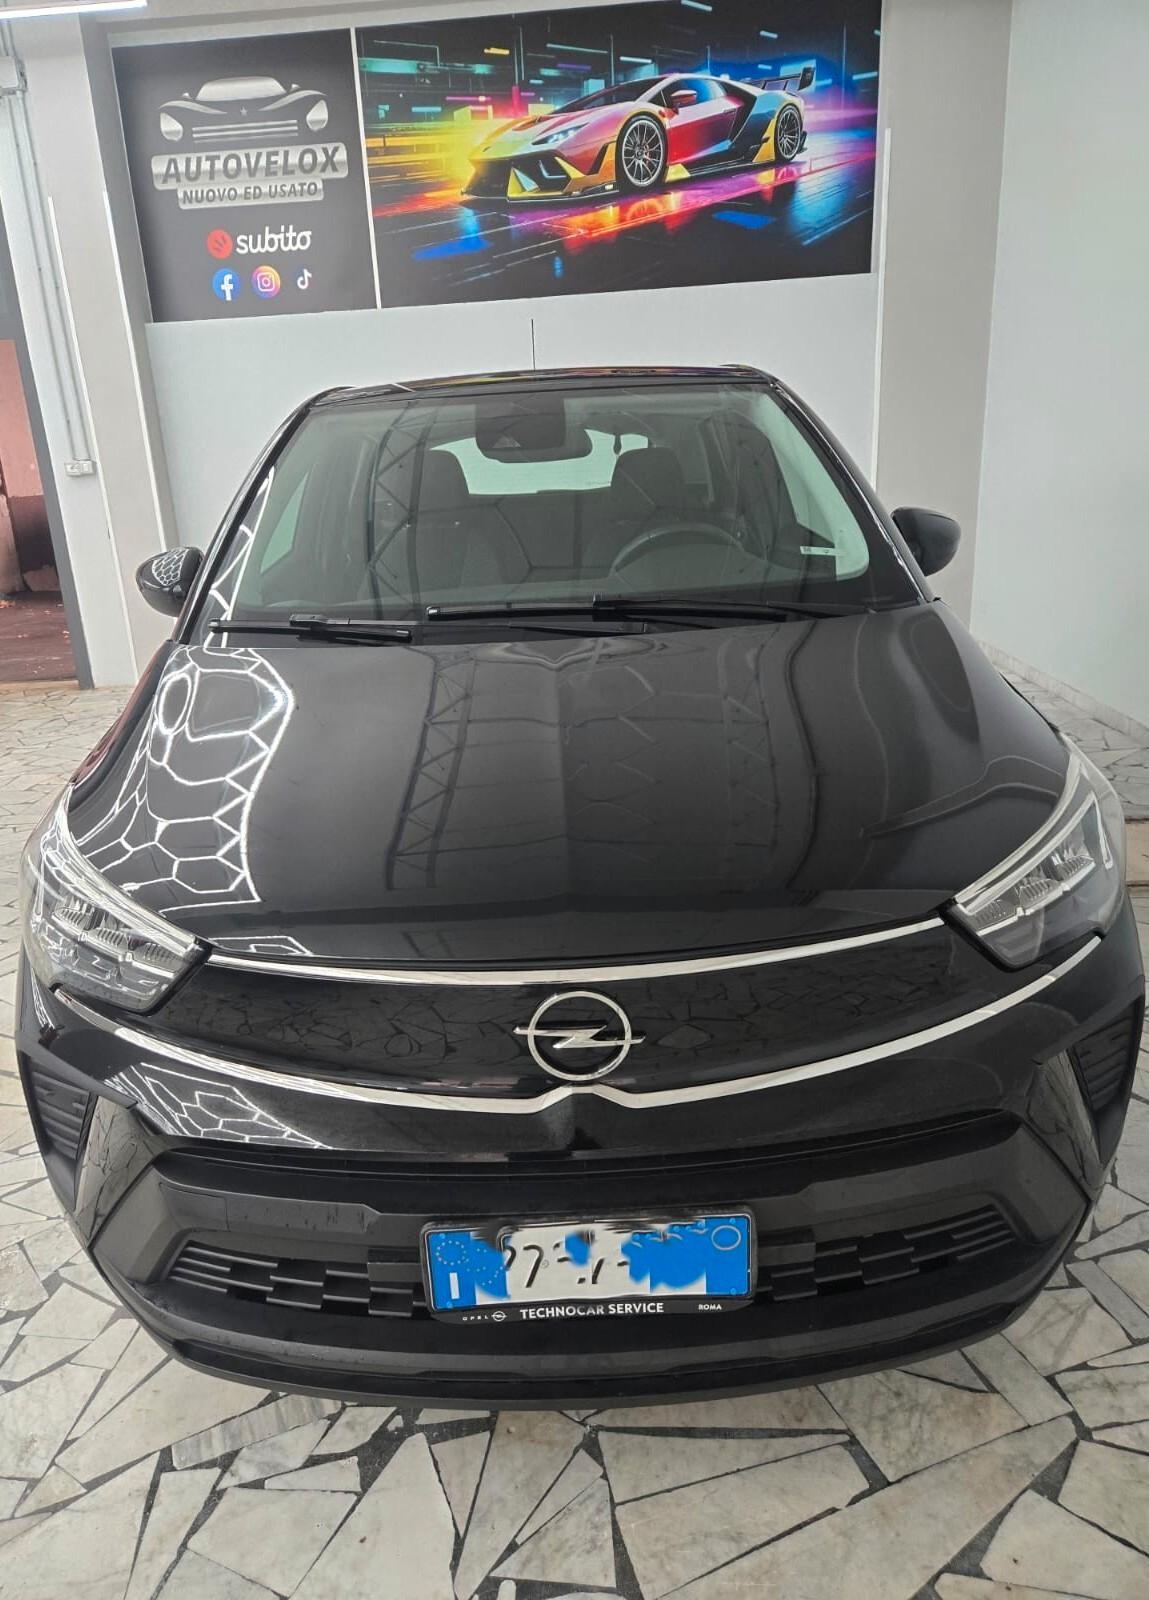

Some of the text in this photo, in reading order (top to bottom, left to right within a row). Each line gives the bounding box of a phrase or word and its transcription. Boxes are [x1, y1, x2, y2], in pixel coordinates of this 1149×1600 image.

[162, 146, 340, 184] AUTOVELOX
[182, 181, 318, 204] NUOVO ED USATO
[235, 224, 312, 255] subito
[519, 1302, 665, 1320] TECHNOCAR SERVICE
[697, 1303, 723, 1312] ROMA
